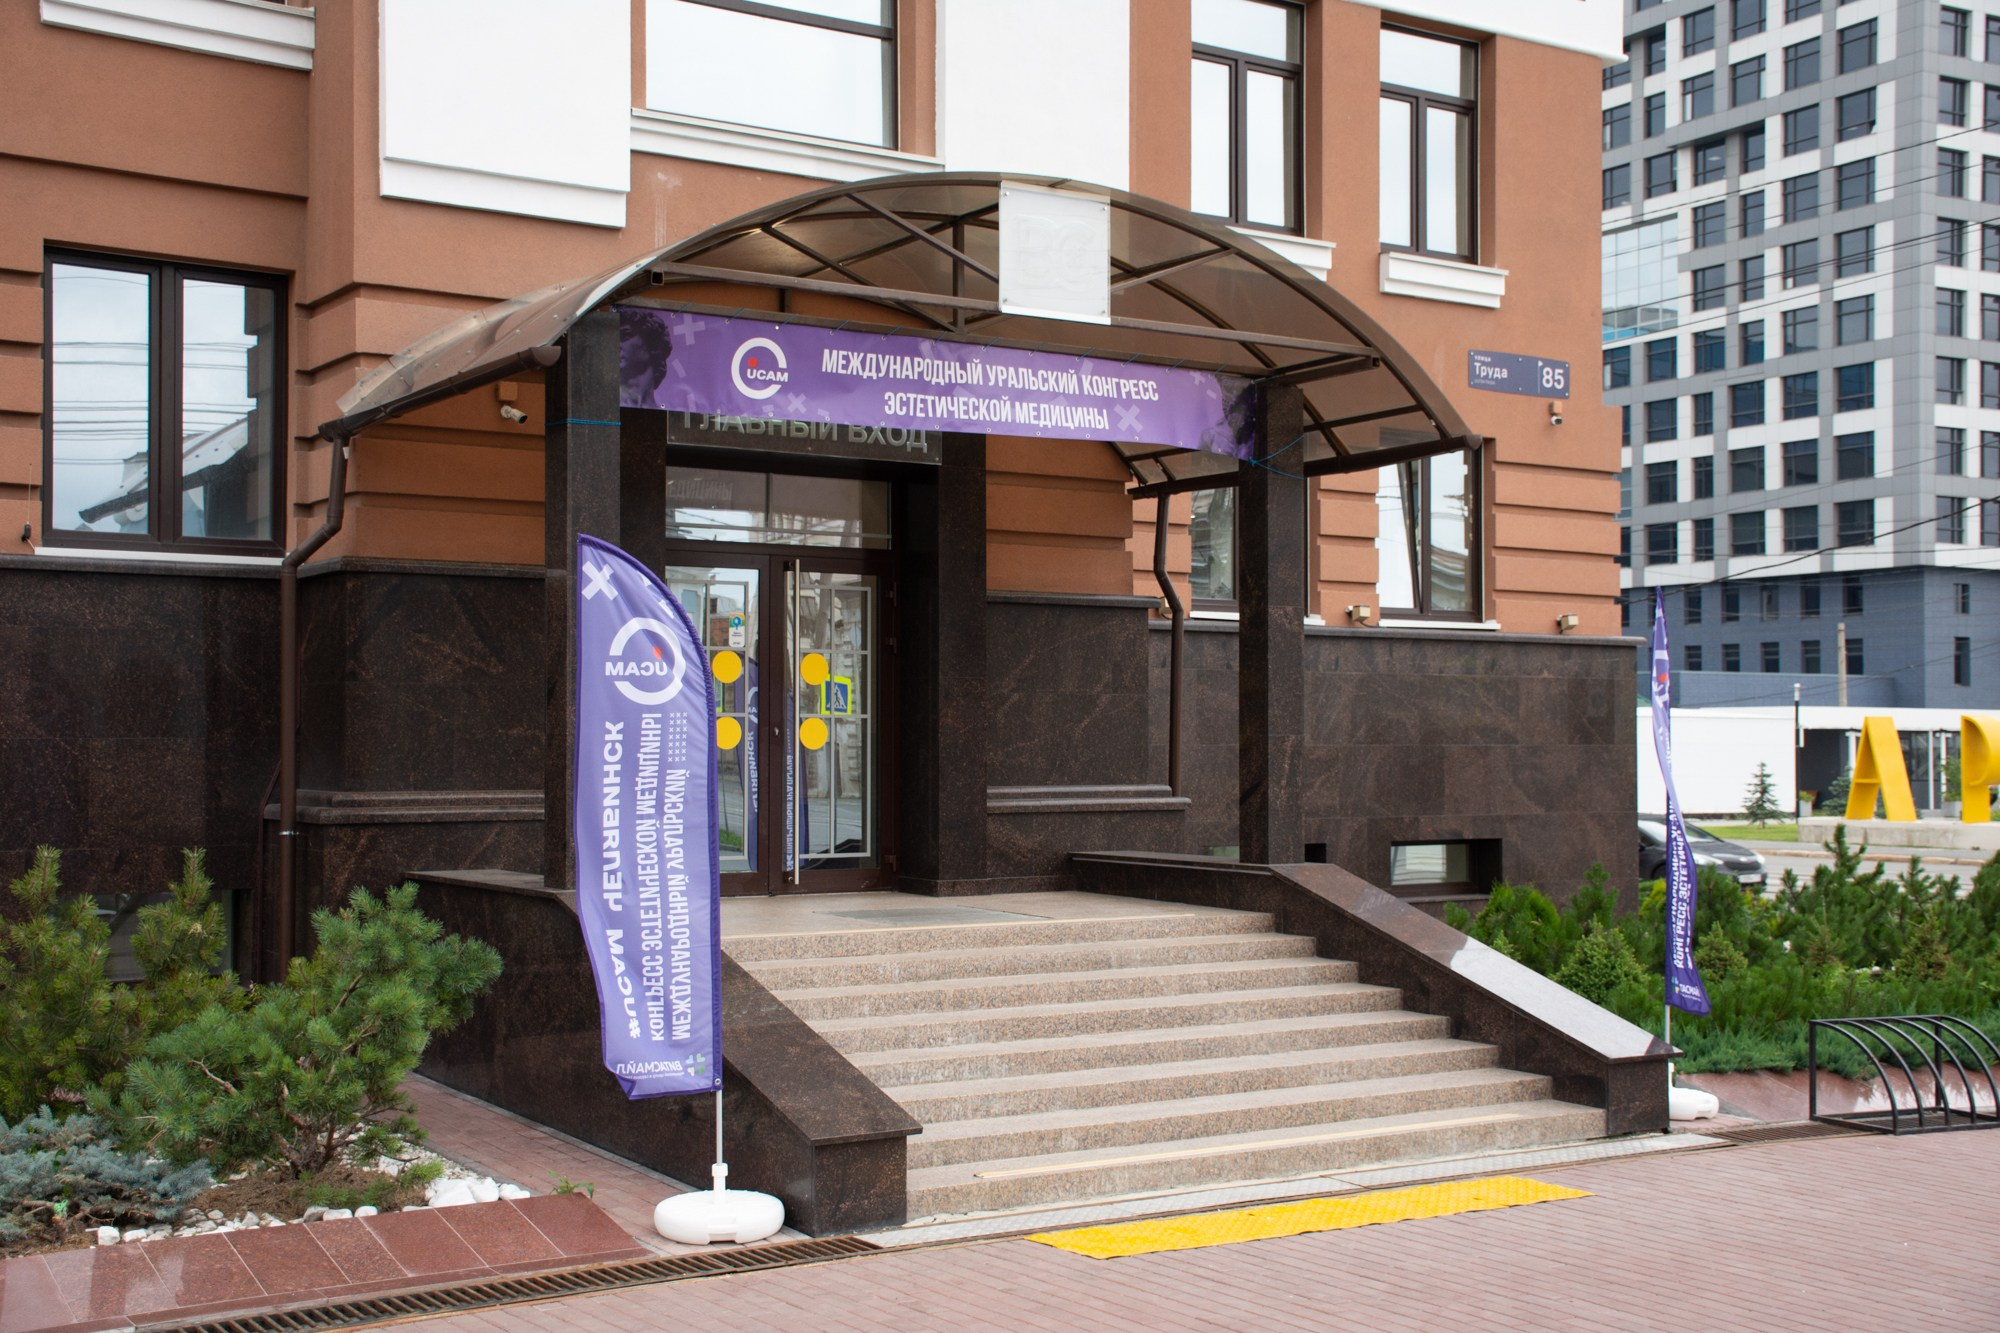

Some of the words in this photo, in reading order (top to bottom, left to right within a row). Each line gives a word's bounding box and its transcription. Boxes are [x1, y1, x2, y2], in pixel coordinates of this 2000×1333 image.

[747, 368, 789, 382] UCAM
[822, 349, 983, 386] МЕЖДУНАРОДНЫЙ
[987, 363, 1079, 395] УРАЛЬСКИЙ
[1082, 375, 1159, 401] КОНГРЕСС
[1474, 362, 1508, 379] Труда
[1542, 367, 1565, 389] 85
[884, 391, 1012, 422] ЭСТЕТИЧЕСКОЙ
[1015, 400, 1110, 430] МЕДИЦИНЫ
[848, 424, 928, 454] ВХОД
[1674, 902, 1687, 969] КОНГРЕСС
